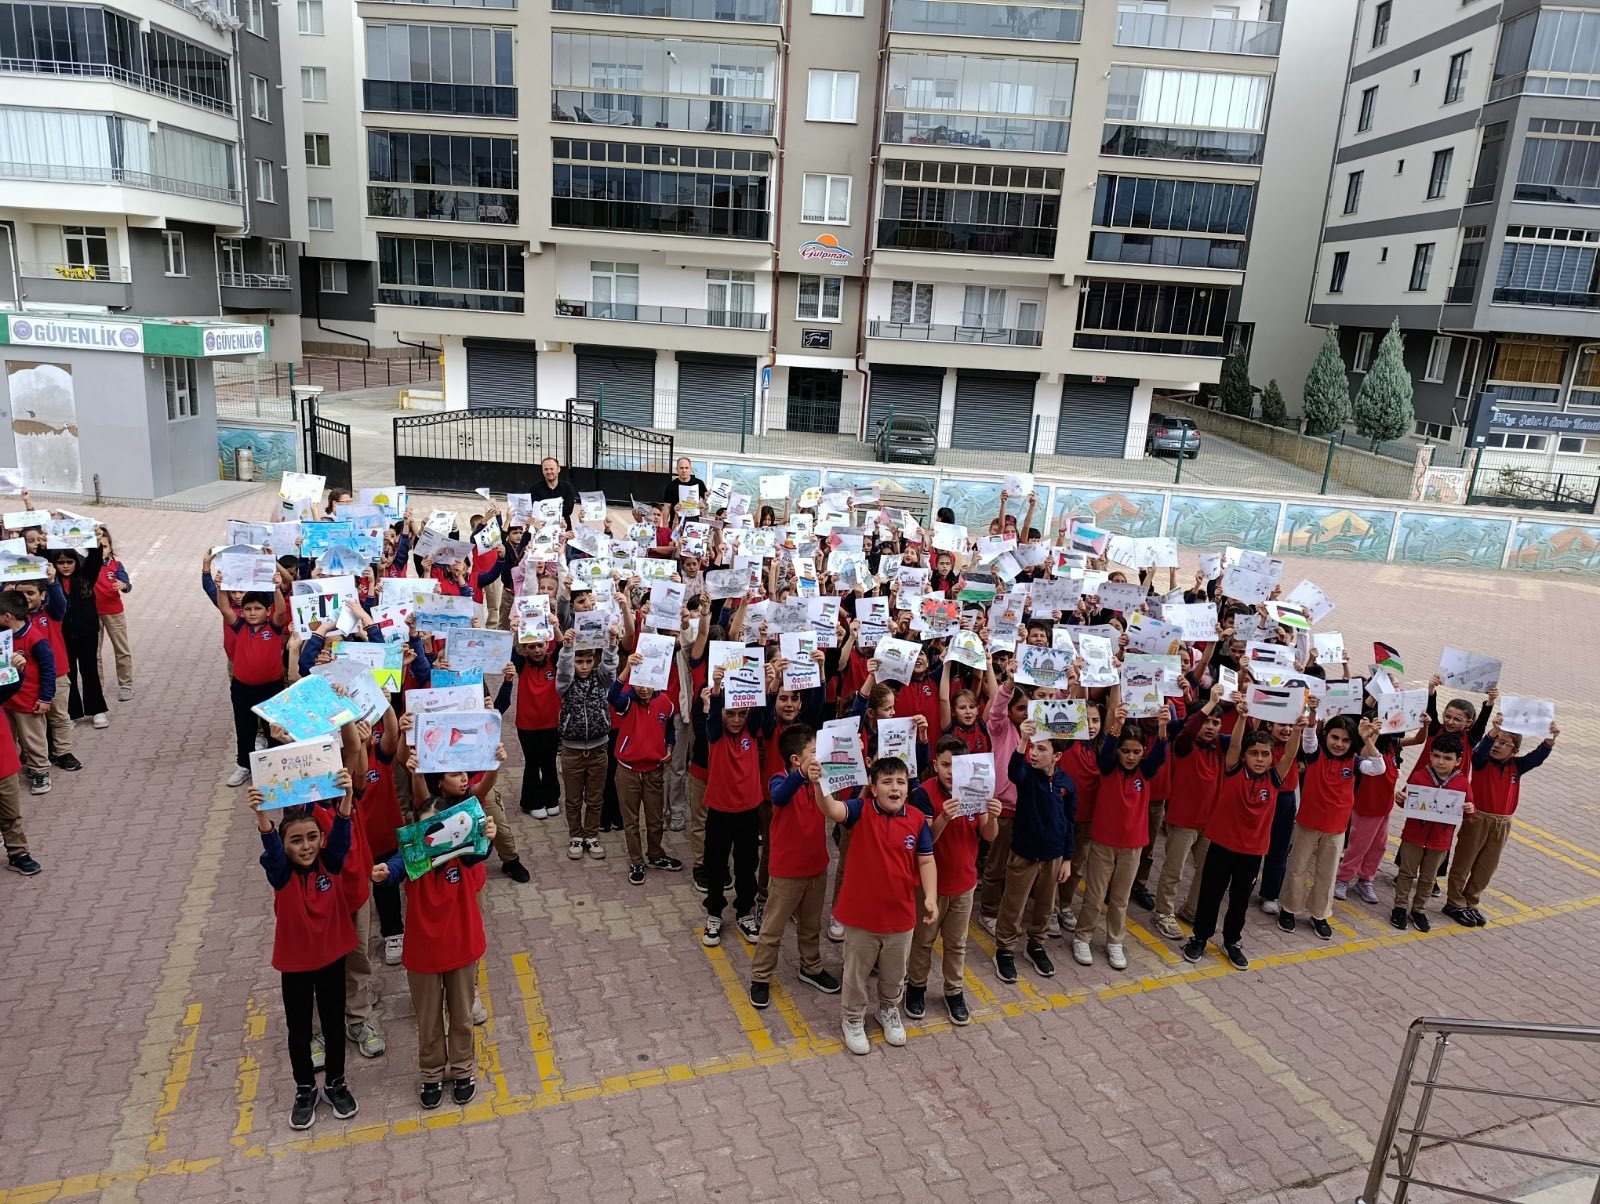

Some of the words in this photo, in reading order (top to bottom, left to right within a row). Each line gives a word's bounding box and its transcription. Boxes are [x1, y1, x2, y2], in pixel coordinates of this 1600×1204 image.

[34, 321, 118, 347] GÜVENLİK
[216, 331, 254, 350] GÜVENLİK
[733, 693, 756, 701] ÖZGÜR
[829, 774, 856, 784] ÖZGÜR
